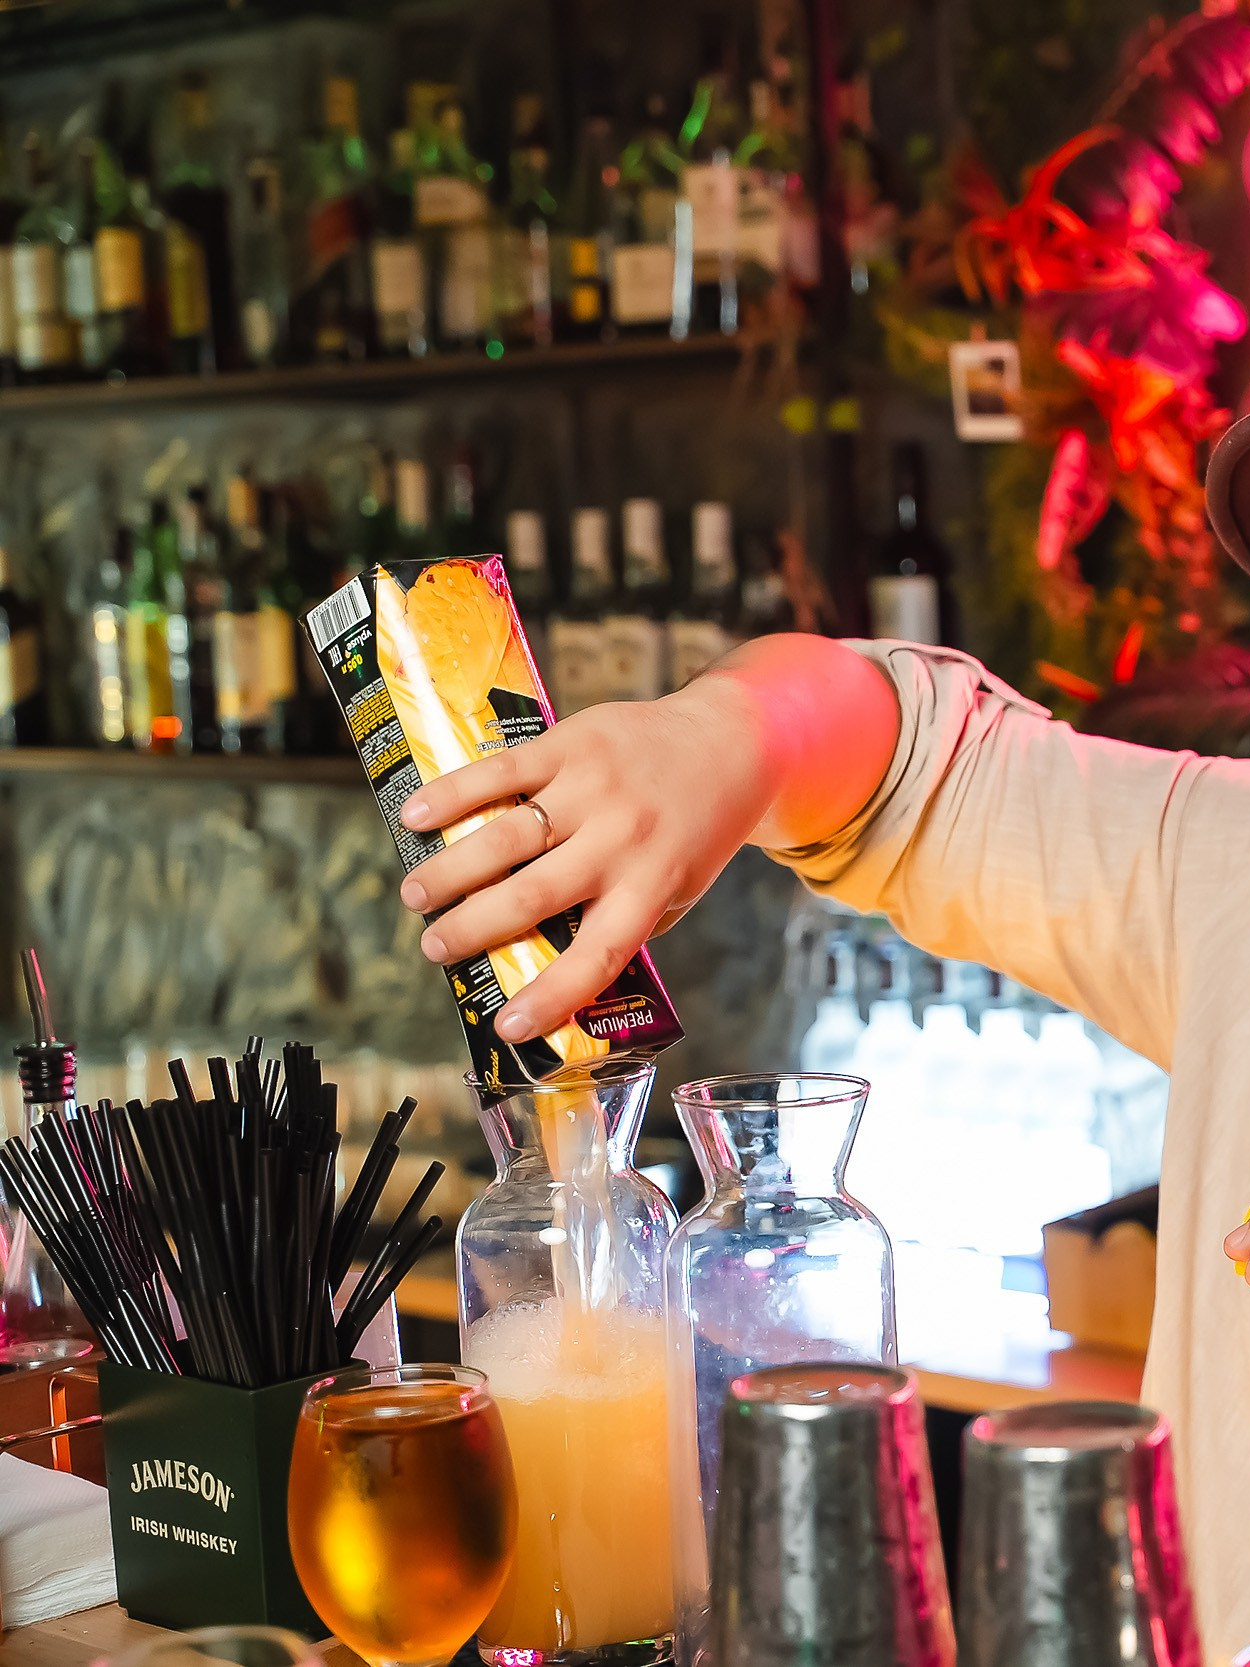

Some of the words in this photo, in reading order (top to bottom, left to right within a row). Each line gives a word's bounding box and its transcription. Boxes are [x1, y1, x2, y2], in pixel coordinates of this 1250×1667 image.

[341, 664, 348, 675] л
[347, 654, 364, 673] 0,95
[588, 1009, 654, 1036] PREMIUM
[130, 1459, 234, 1513] JAMESON
[130, 1515, 169, 1539] IRISH
[172, 1525, 238, 1555] WHISKEY
